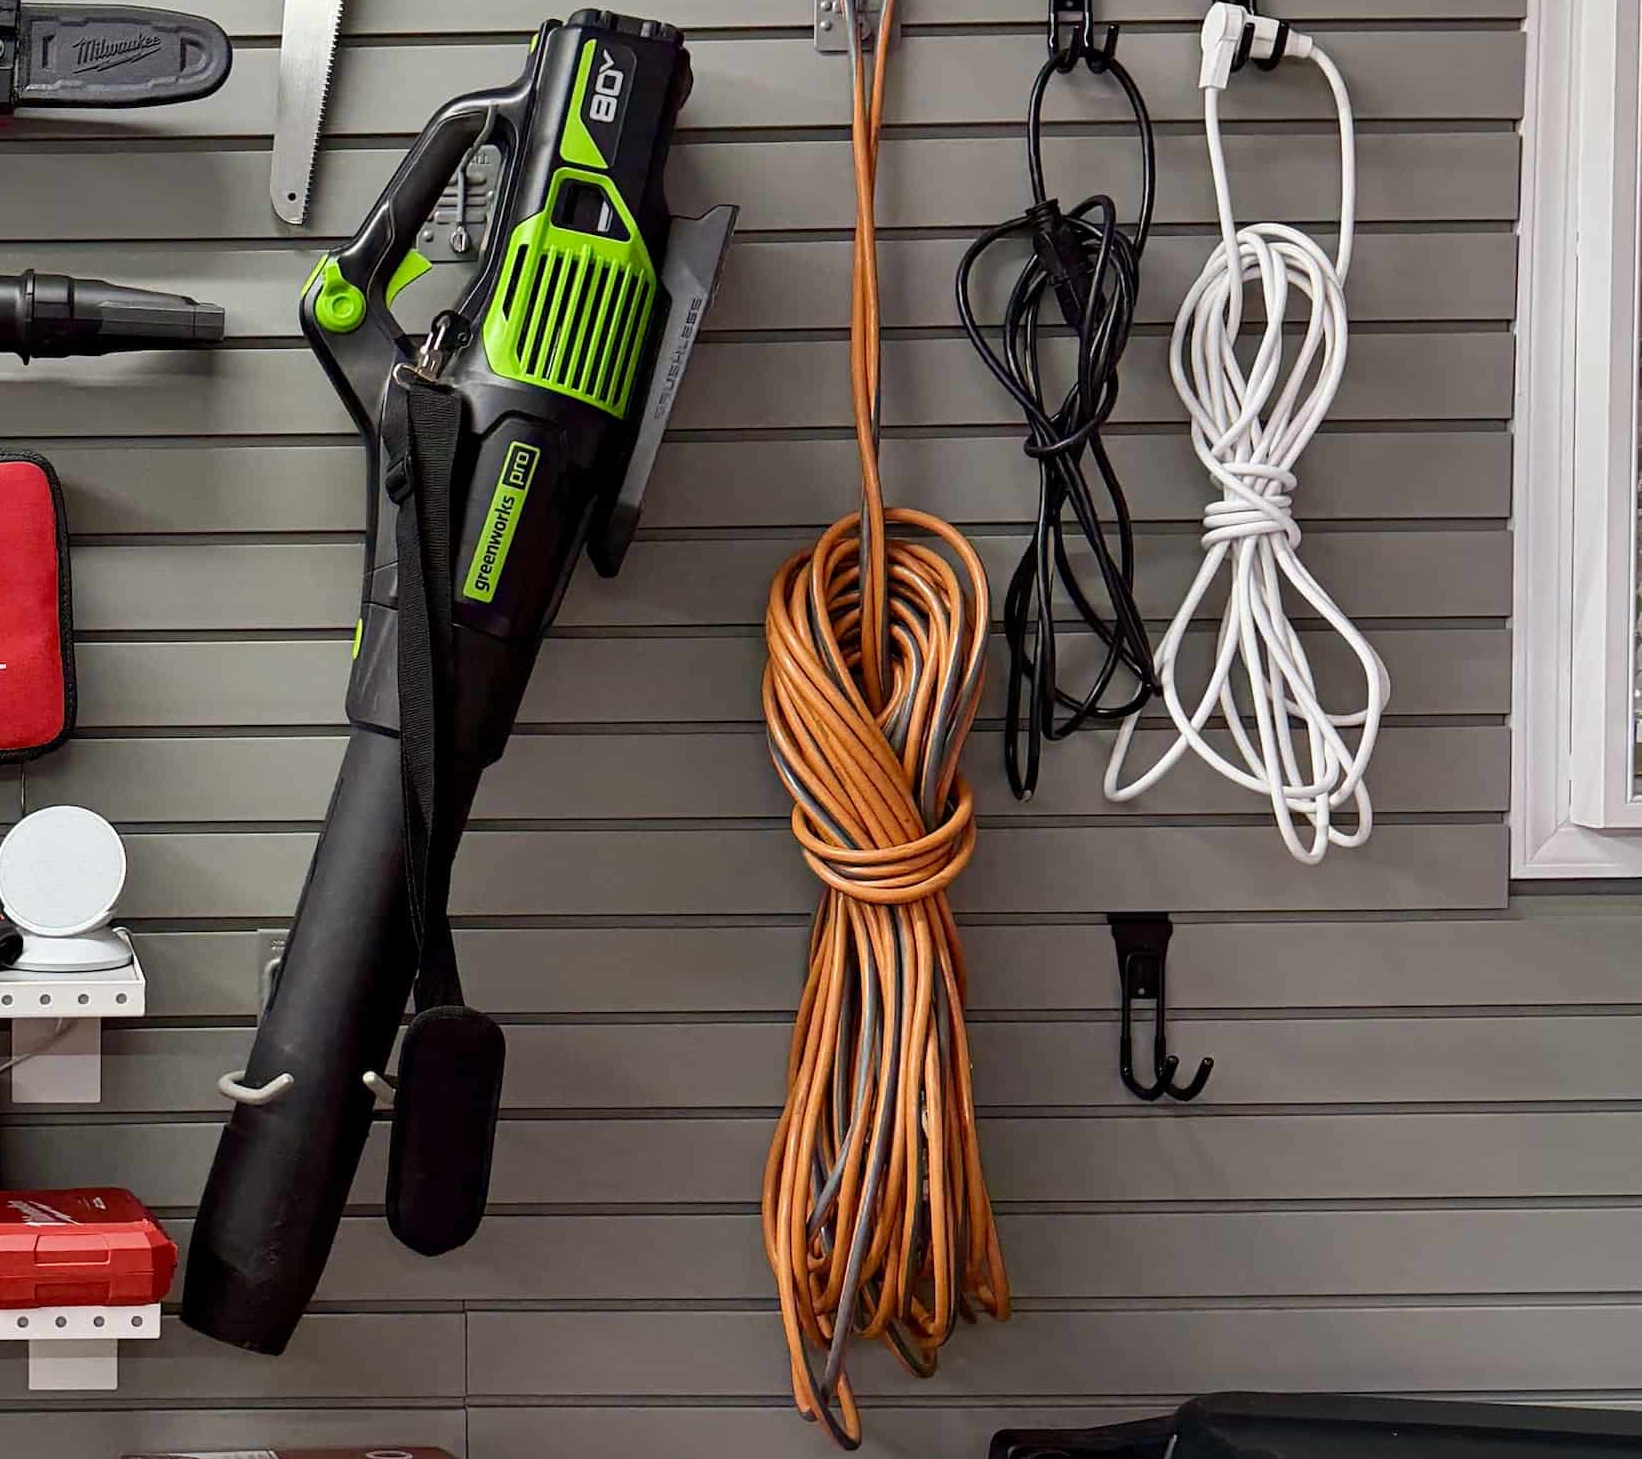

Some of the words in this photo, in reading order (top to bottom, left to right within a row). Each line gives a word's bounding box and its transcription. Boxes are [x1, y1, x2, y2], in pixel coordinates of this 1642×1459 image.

[72, 33, 161, 65] Milwaukee
[475, 495, 515, 593] greenworks
[509, 451, 530, 485] pro
